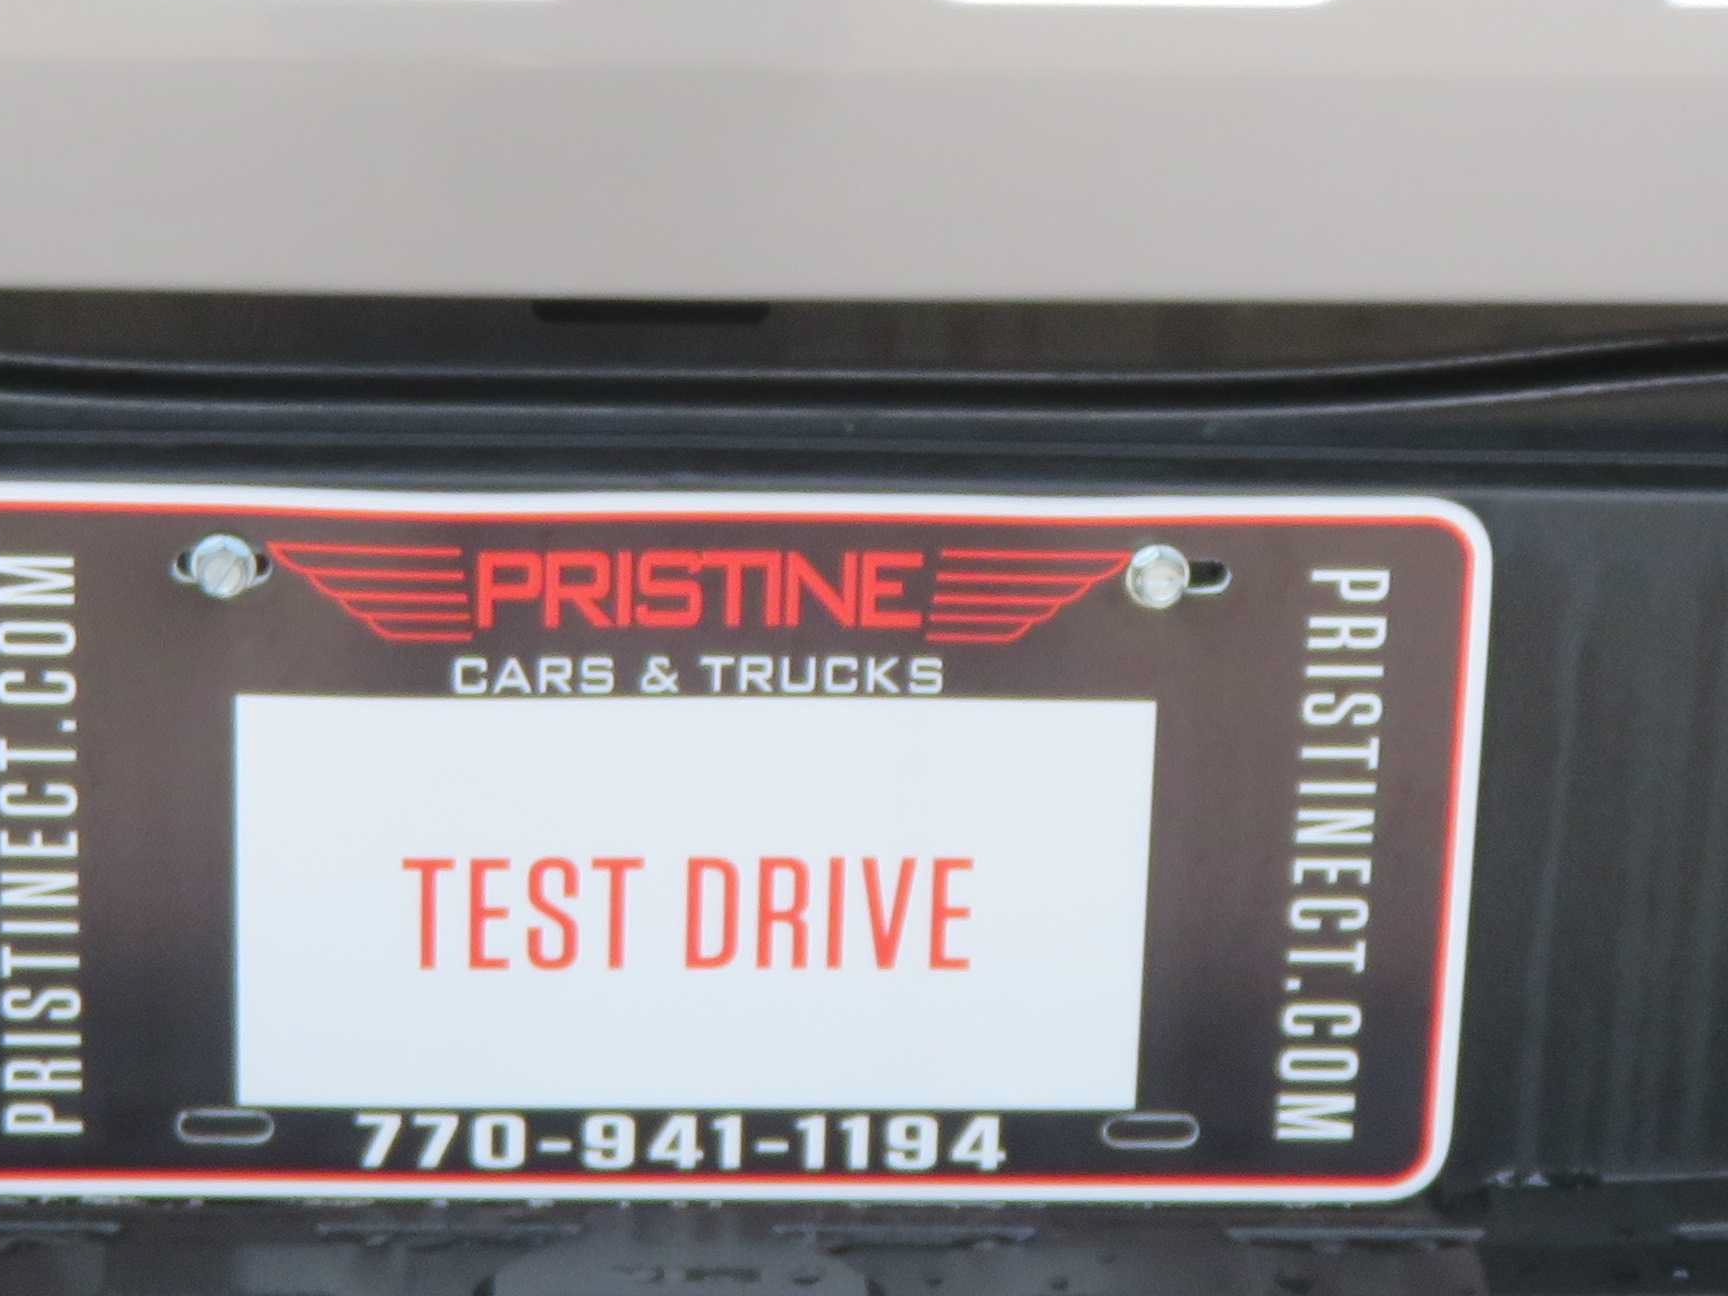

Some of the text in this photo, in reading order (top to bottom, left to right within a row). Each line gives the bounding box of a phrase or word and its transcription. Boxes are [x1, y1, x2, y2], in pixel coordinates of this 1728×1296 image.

[475, 549, 924, 631] PRISTINE
[451, 654, 946, 695] CARS & TRUCKS
[1275, 567, 1390, 1142] PRISTINECT.COM
[402, 855, 975, 971] TEST DRIVE
[355, 1111, 1009, 1171] 770-941-1194
